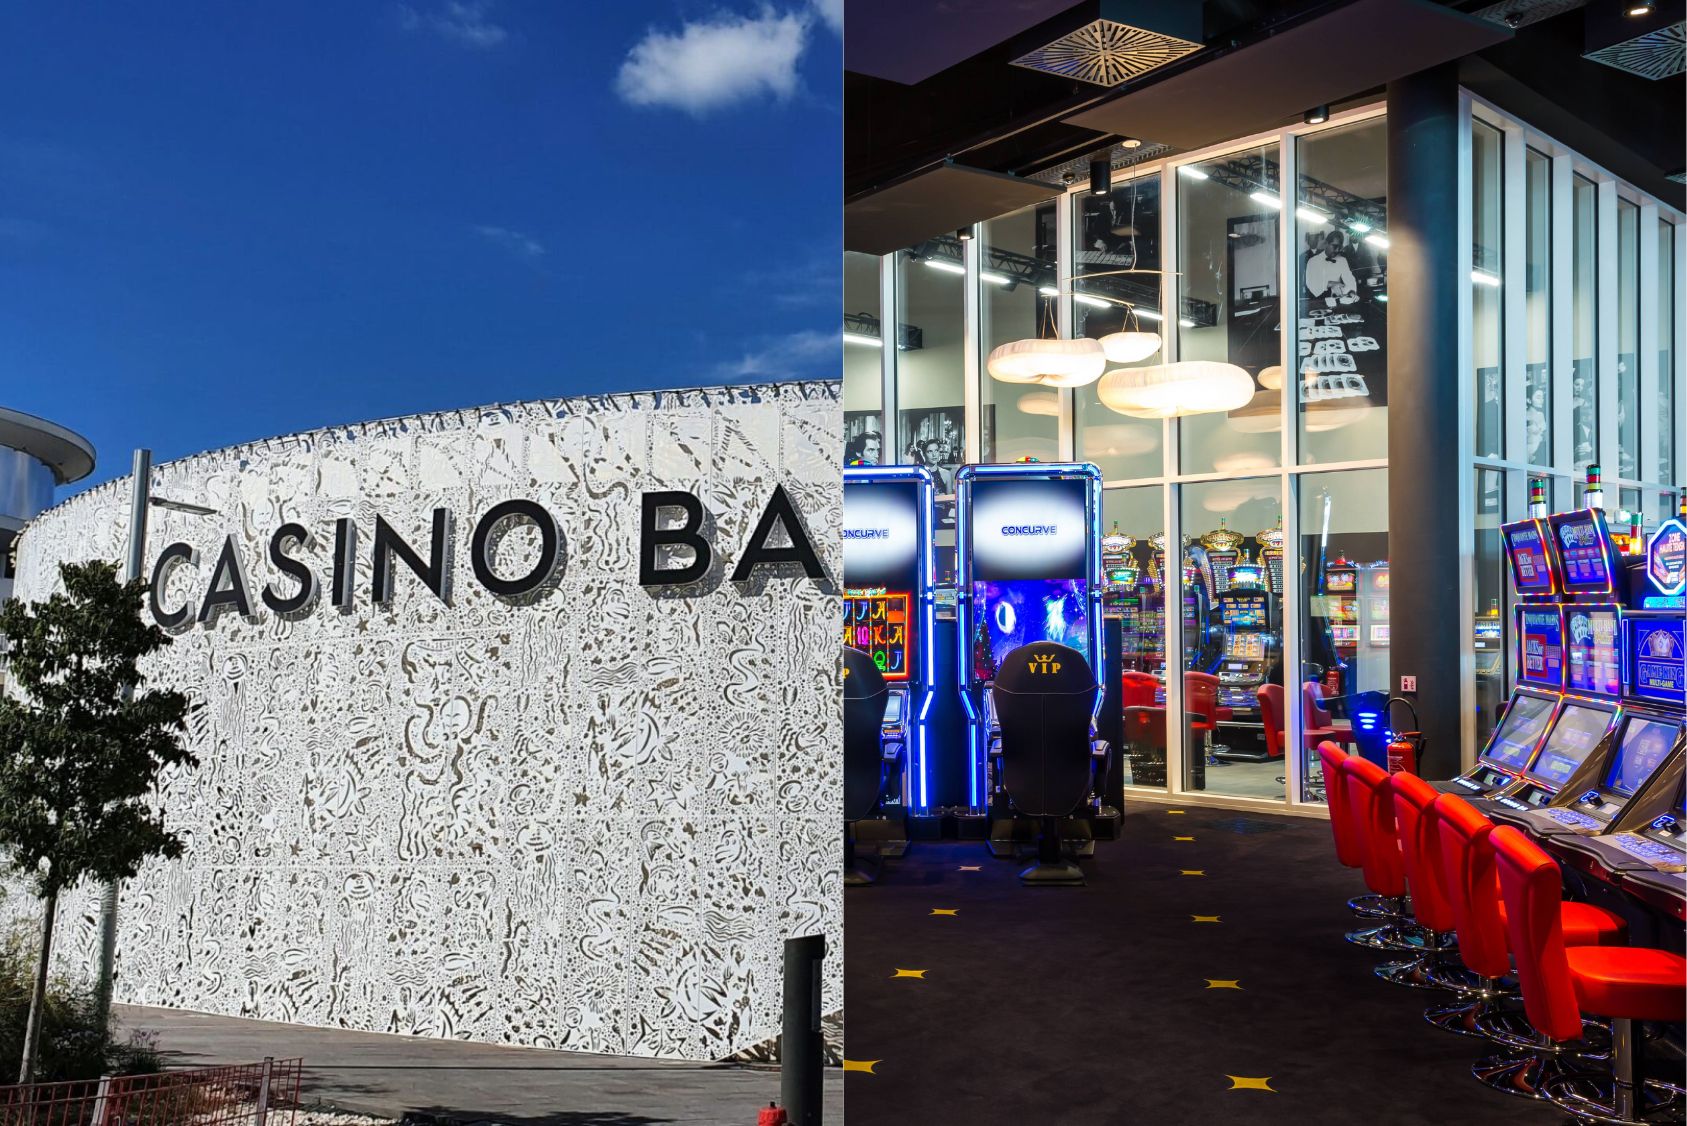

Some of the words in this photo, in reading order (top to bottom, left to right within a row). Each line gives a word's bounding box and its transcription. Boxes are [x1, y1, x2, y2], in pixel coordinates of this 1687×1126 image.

[1001, 526, 1057, 536] CONCURVE
[150, 499, 561, 629] CASINO
[639, 483, 828, 586] BA
[1028, 662, 1062, 674] VIP
[1649, 678, 1675, 689] MULTI-GAME
